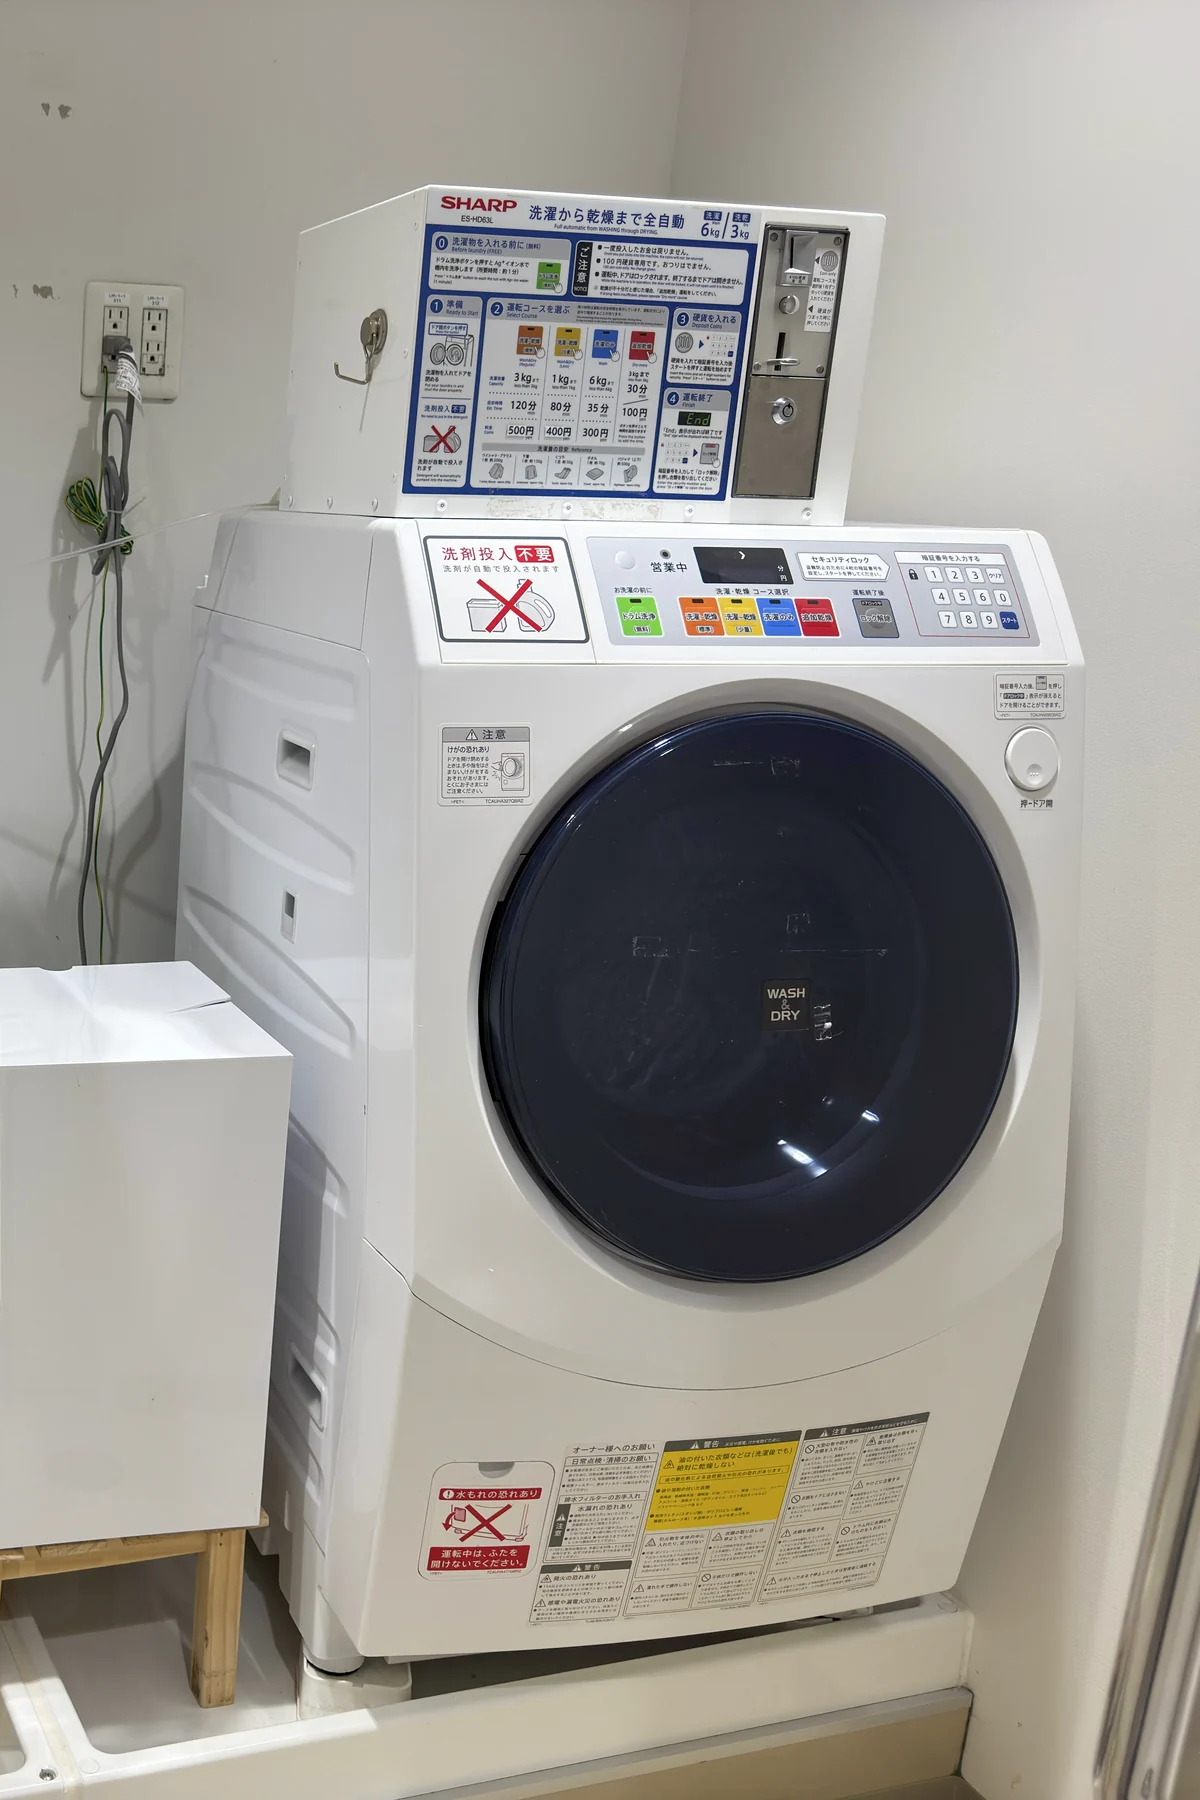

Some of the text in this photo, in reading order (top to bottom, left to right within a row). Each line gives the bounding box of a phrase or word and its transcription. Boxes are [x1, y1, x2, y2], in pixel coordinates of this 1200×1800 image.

[441, 196, 517, 212] SHARP
[461, 215, 493, 224] ES-HD63L
[529, 205, 684, 229] 洗濯から乾燥まで全自動
[447, 301, 463, 309] 準備
[507, 303, 570, 314] 運転コースを選ぶ
[693, 313, 736, 323] 硬貨を入れる
[682, 393, 713, 402] 運転終了
[442, 547, 552, 561] 洗剤投入 不要
[922, 554, 980, 562] 暗証番号を入力する
[811, 556, 869, 564] セキュリティロック
[443, 565, 559, 573] 洗剤が自動で投入されます
[651, 562, 688, 573] 営業中
[932, 571, 937, 579] 1
[953, 571, 958, 579] 2
[959, 593, 965, 601] 5
[980, 593, 986, 602] 6
[1000, 593, 1006, 602] 0
[861, 615, 891, 623] ロック解除
[945, 615, 950, 624] 7
[966, 616, 972, 624] 8
[986, 616, 992, 624] 9
[483, 730, 506, 739] 注意
[767, 988, 805, 998] WASH
[781, 1000, 790, 1009] &
[771, 1011, 800, 1021] DRY
[573, 1444, 655, 1453] オーナー様へのお願い
[677, 1462, 735, 1471] 絶対に乾燥しない
[456, 1489, 538, 1499] 水もれの恐れあり
[564, 1494, 641, 1503] 排水フィルターのお手入れ
[578, 1504, 633, 1512] 水漏れの恐れあり
[441, 1549, 518, 1558] 運転中は、ふたを
[431, 1559, 524, 1569] 開けないでください。
